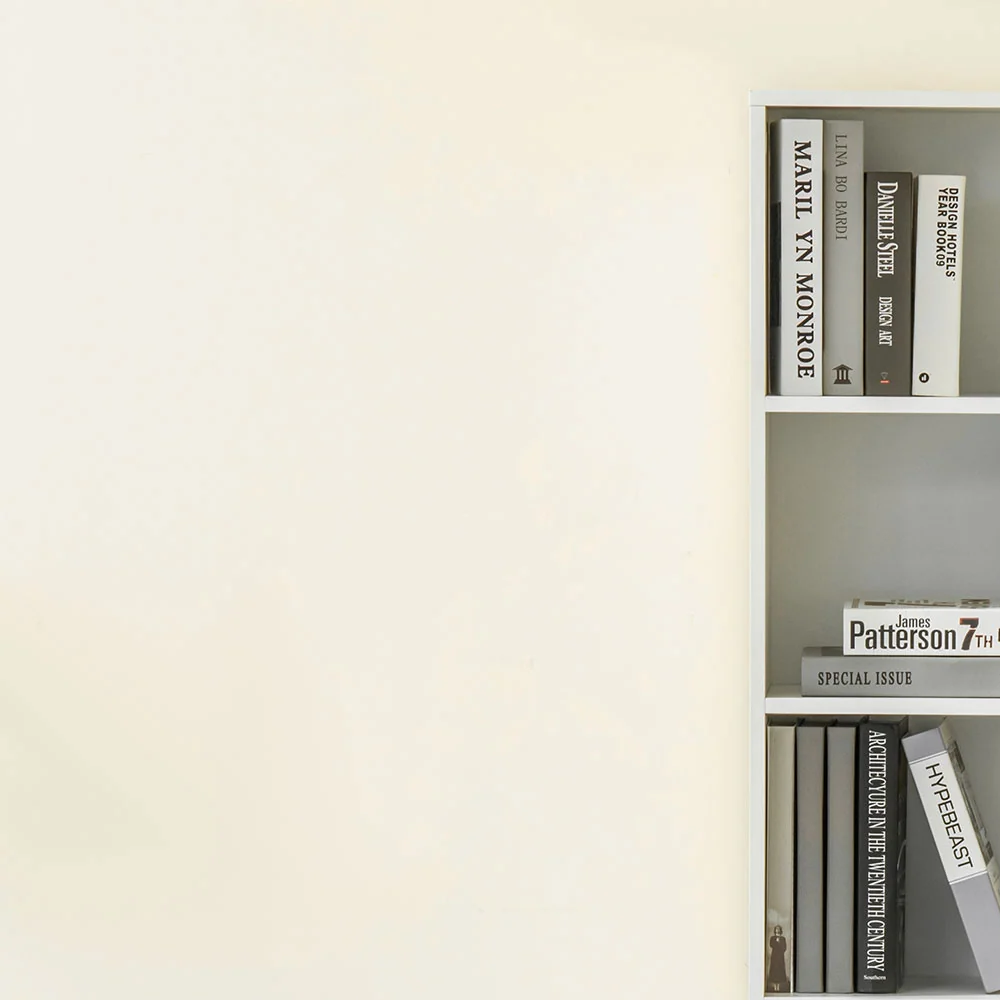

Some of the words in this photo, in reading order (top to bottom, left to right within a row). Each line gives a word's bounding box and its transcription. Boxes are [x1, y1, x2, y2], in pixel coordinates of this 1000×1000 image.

[835, 134, 848, 167] LINA
[794, 140, 813, 219] MARIL
[835, 175, 848, 193] BO
[937, 187, 949, 217] YEAR
[948, 187, 959, 229] DESIGN
[835, 200, 848, 241] BARDI
[795, 229, 813, 264] YN
[936, 221, 948, 267] BOOK09
[796, 273, 815, 379] MONROE
[878, 296, 893, 327] DESIGN
[878, 329, 893, 347] ART
[849, 620, 957, 650] Patterson
[895, 614, 931, 629] James
[817, 671, 871, 686] SPECIAL
[875, 671, 913, 686] ISSUE
[868, 817, 887, 829] IN
[925, 762, 973, 868] HYPEBEAST
[867, 831, 887, 853] THE
[867, 855, 886, 918] TWENTIETH
[866, 919, 886, 972] CENTURY
